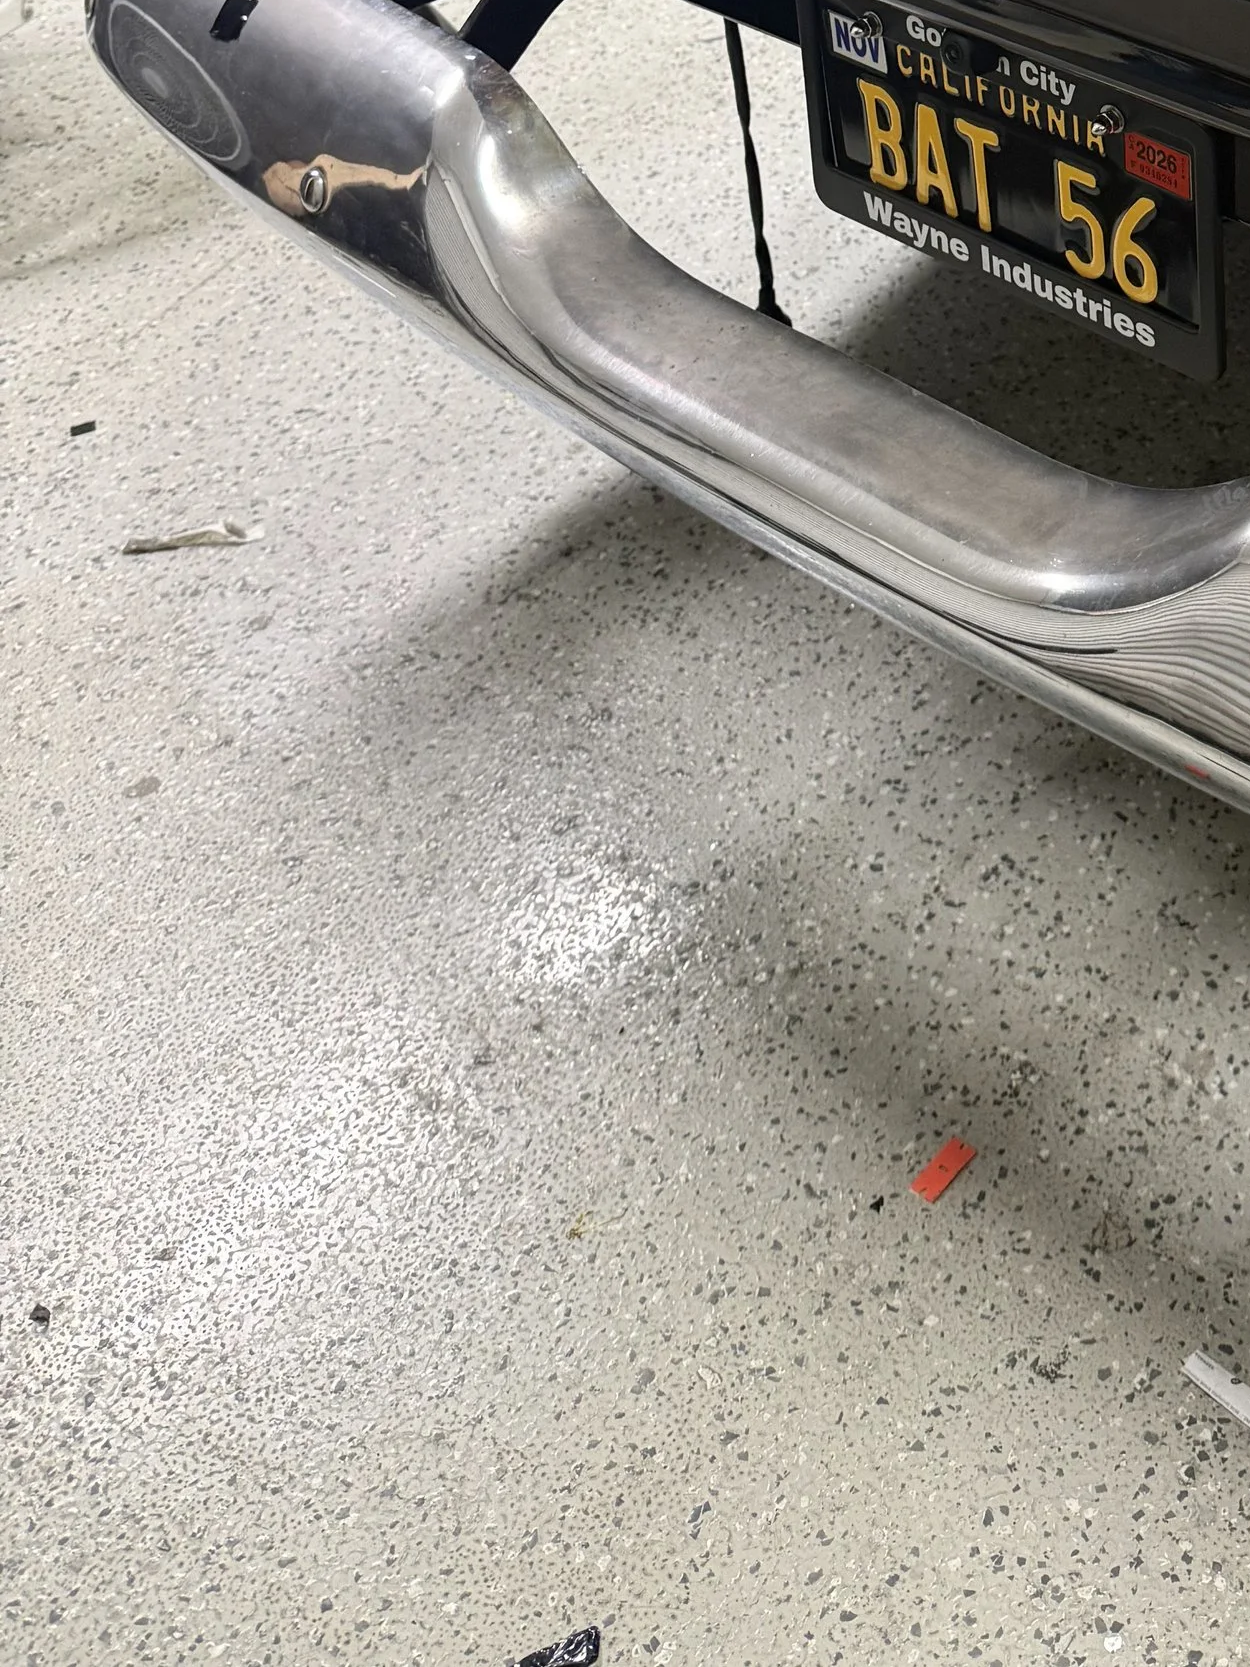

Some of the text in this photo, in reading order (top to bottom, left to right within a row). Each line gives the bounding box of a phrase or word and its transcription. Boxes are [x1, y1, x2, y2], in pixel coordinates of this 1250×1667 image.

[834, 17, 880, 64] NOV
[896, 43, 1106, 157] CALIFORNIA
[1020, 60, 1077, 106] City
[857, 78, 1158, 304] BAT 56
[1136, 141, 1177, 175] 2026
[863, 191, 1157, 348] Wayne Industries
